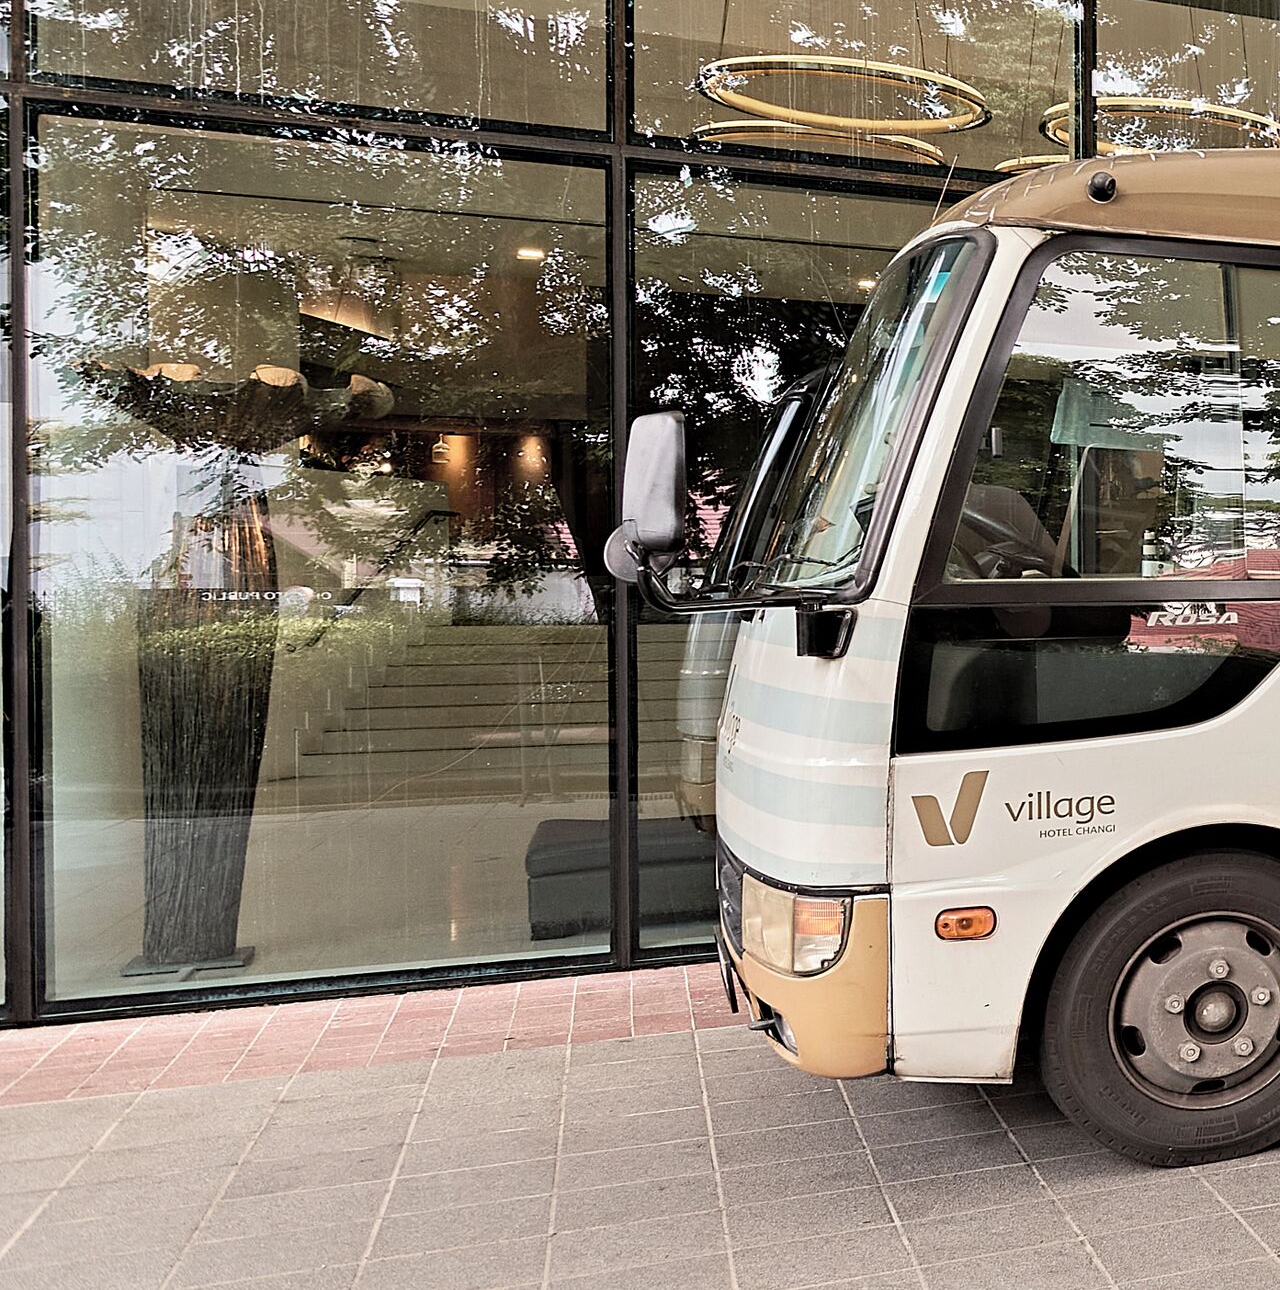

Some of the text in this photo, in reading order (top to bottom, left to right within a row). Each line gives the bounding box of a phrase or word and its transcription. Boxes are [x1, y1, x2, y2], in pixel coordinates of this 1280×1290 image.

[1146, 611, 1238, 627] ROSA
[1004, 790, 1116, 825] village
[1039, 824, 1116, 839] HOTEL CHANGI
